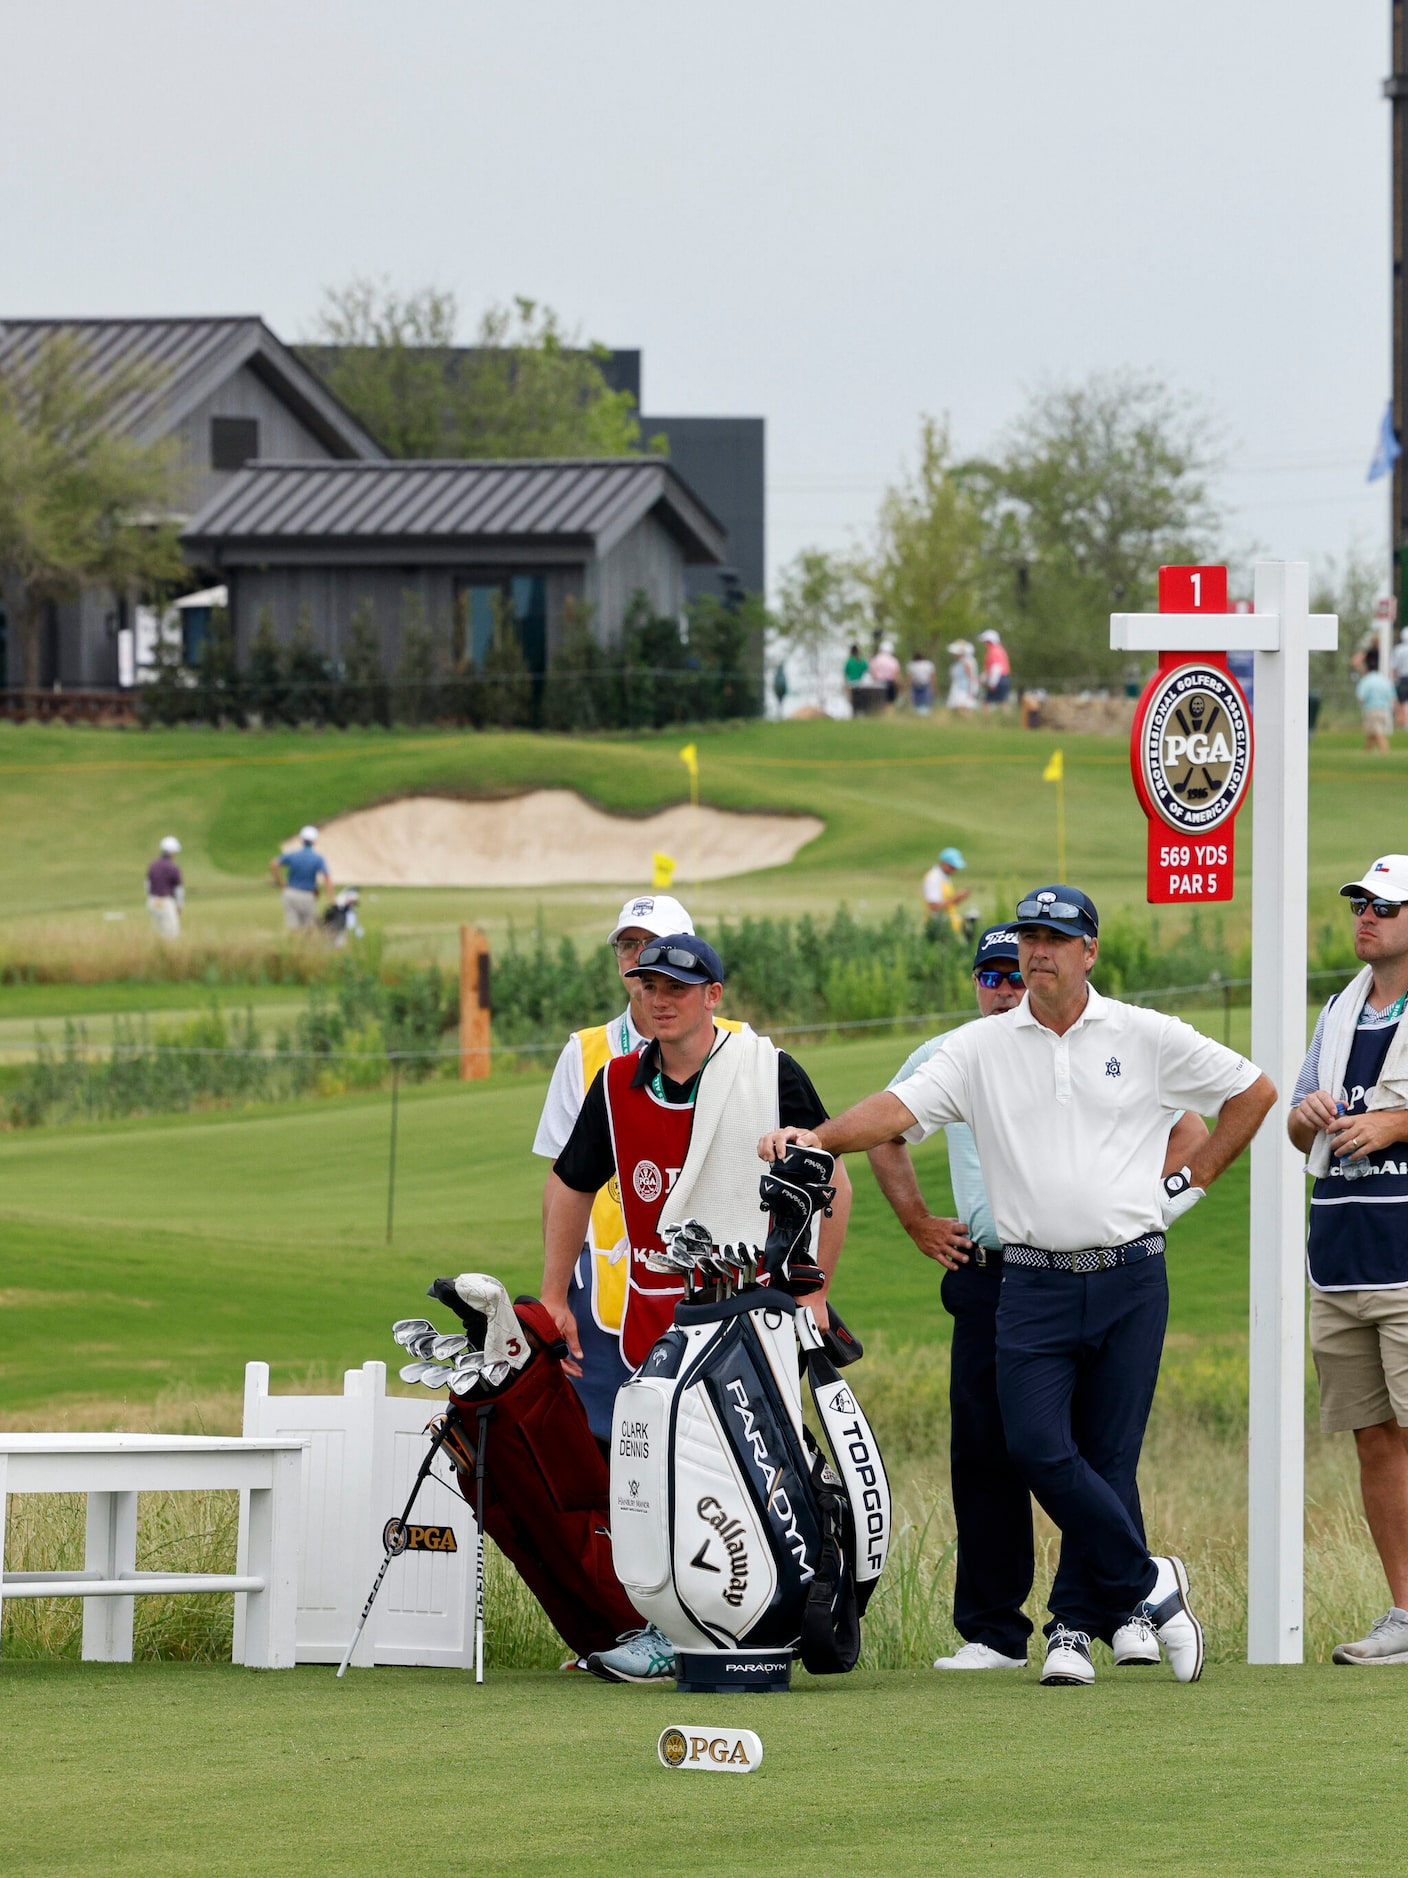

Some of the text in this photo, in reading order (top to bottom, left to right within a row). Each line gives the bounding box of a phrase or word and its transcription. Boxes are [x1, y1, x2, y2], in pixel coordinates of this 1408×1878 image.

[1189, 572, 1202, 607] 1
[1149, 690, 1178, 800] PROFESSIONAL
[1164, 732, 1233, 767] PGA
[1223, 694, 1246, 794] ASSOCIATION
[1168, 797, 1230, 824] OF AMERICA
[1159, 845, 1228, 868] 569 YDS
[1169, 873, 1218, 895] PAR 5
[638, 1177, 657, 1185] PGA
[505, 1337, 522, 1357] 3
[836, 1326, 853, 1345] 1
[621, 1420, 649, 1440] CLARK
[619, 1439, 650, 1459] DENNIS
[726, 1377, 815, 1584] PARADYM
[841, 1419, 883, 1571] TOPGOLF
[408, 1526, 458, 1552] PGA
[696, 1495, 750, 1608] Callaway
[725, 1662, 787, 1673] PARADYM
[666, 1743, 684, 1753] PGA
[688, 1736, 750, 1765] PGA
